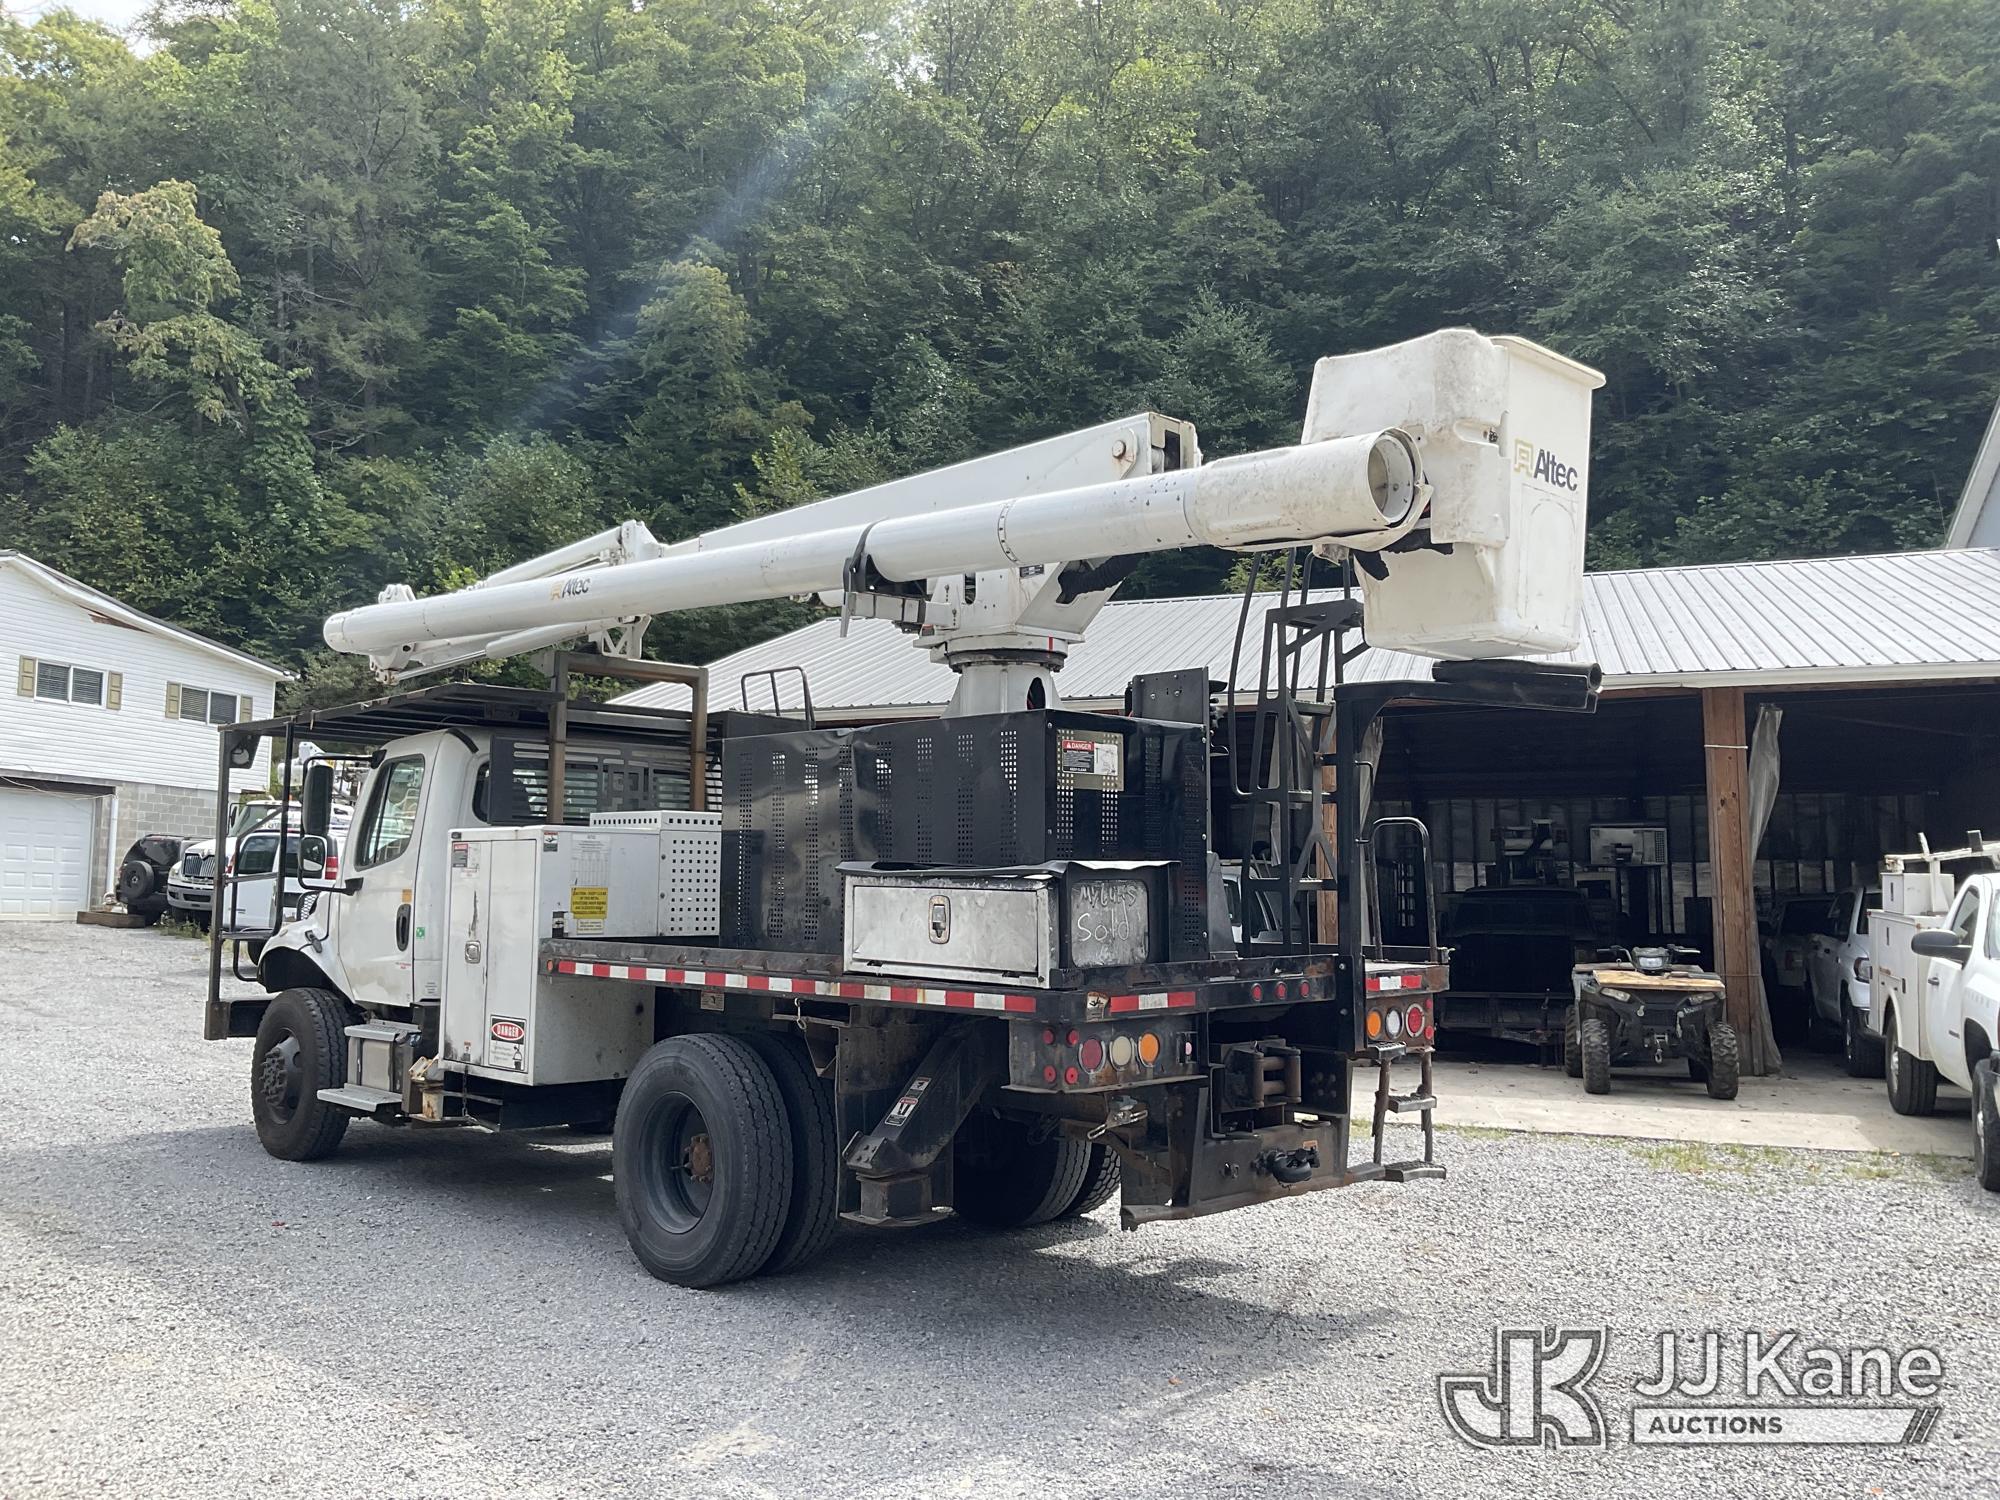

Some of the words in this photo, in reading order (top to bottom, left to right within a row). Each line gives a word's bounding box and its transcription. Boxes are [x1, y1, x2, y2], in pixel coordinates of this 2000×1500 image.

[1533, 448, 1578, 492] Altec
[561, 577, 591, 598] Altec
[1071, 742, 1092, 751] DANGER
[496, 1023, 519, 1038] DANGER
